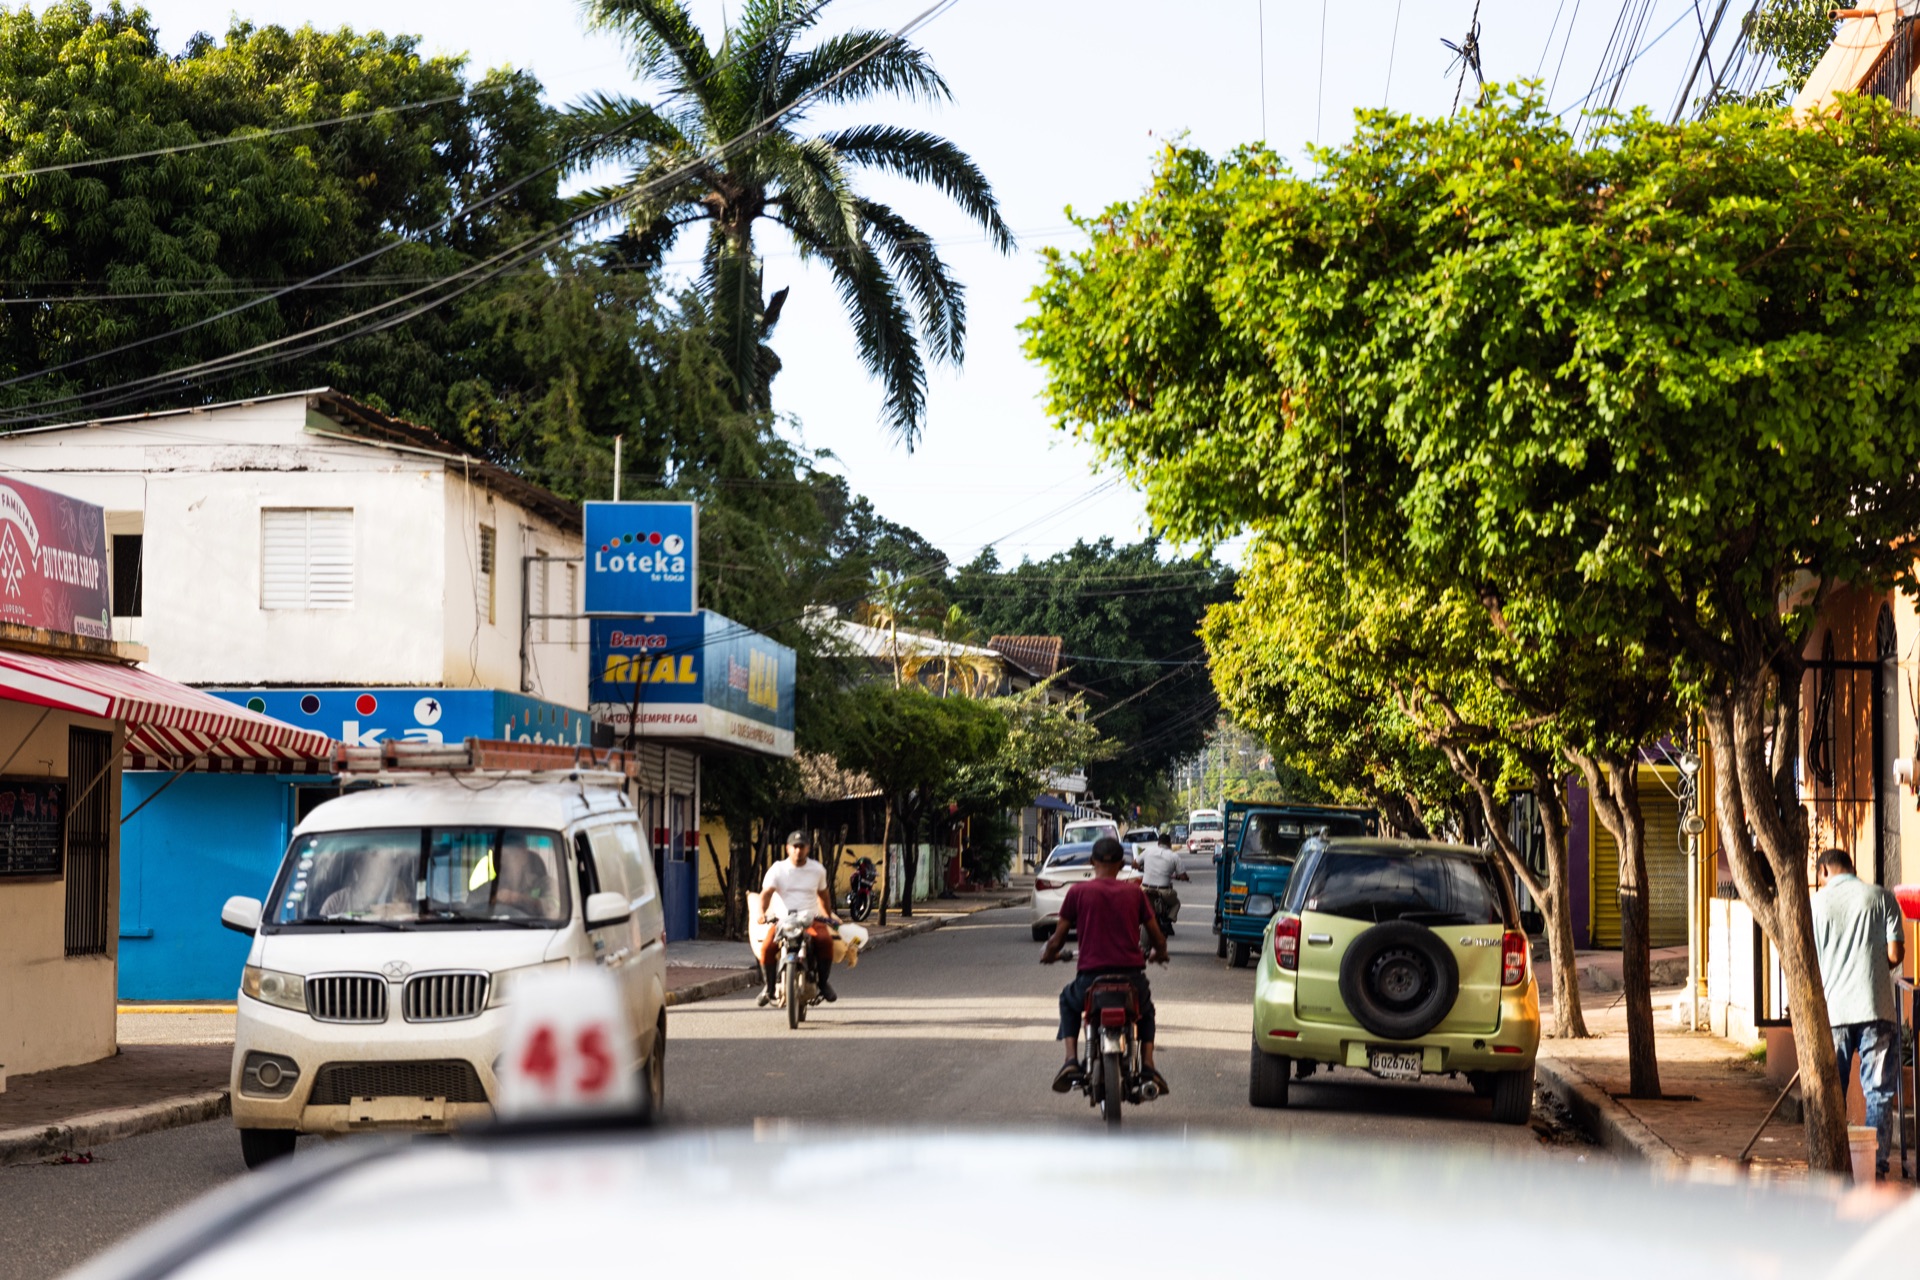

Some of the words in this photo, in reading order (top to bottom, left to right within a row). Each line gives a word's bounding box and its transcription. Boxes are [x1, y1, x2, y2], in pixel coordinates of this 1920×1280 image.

[42, 545, 79, 586] BUTCHER
[79, 554, 99, 590] SHOP
[595, 551, 685, 573] Loteka
[610, 631, 667, 649] Banca
[603, 654, 698, 684] REAL
[615, 713, 634, 724] QU
[635, 713, 672, 724] SIEMPRE
[674, 713, 698, 724] PAGA
